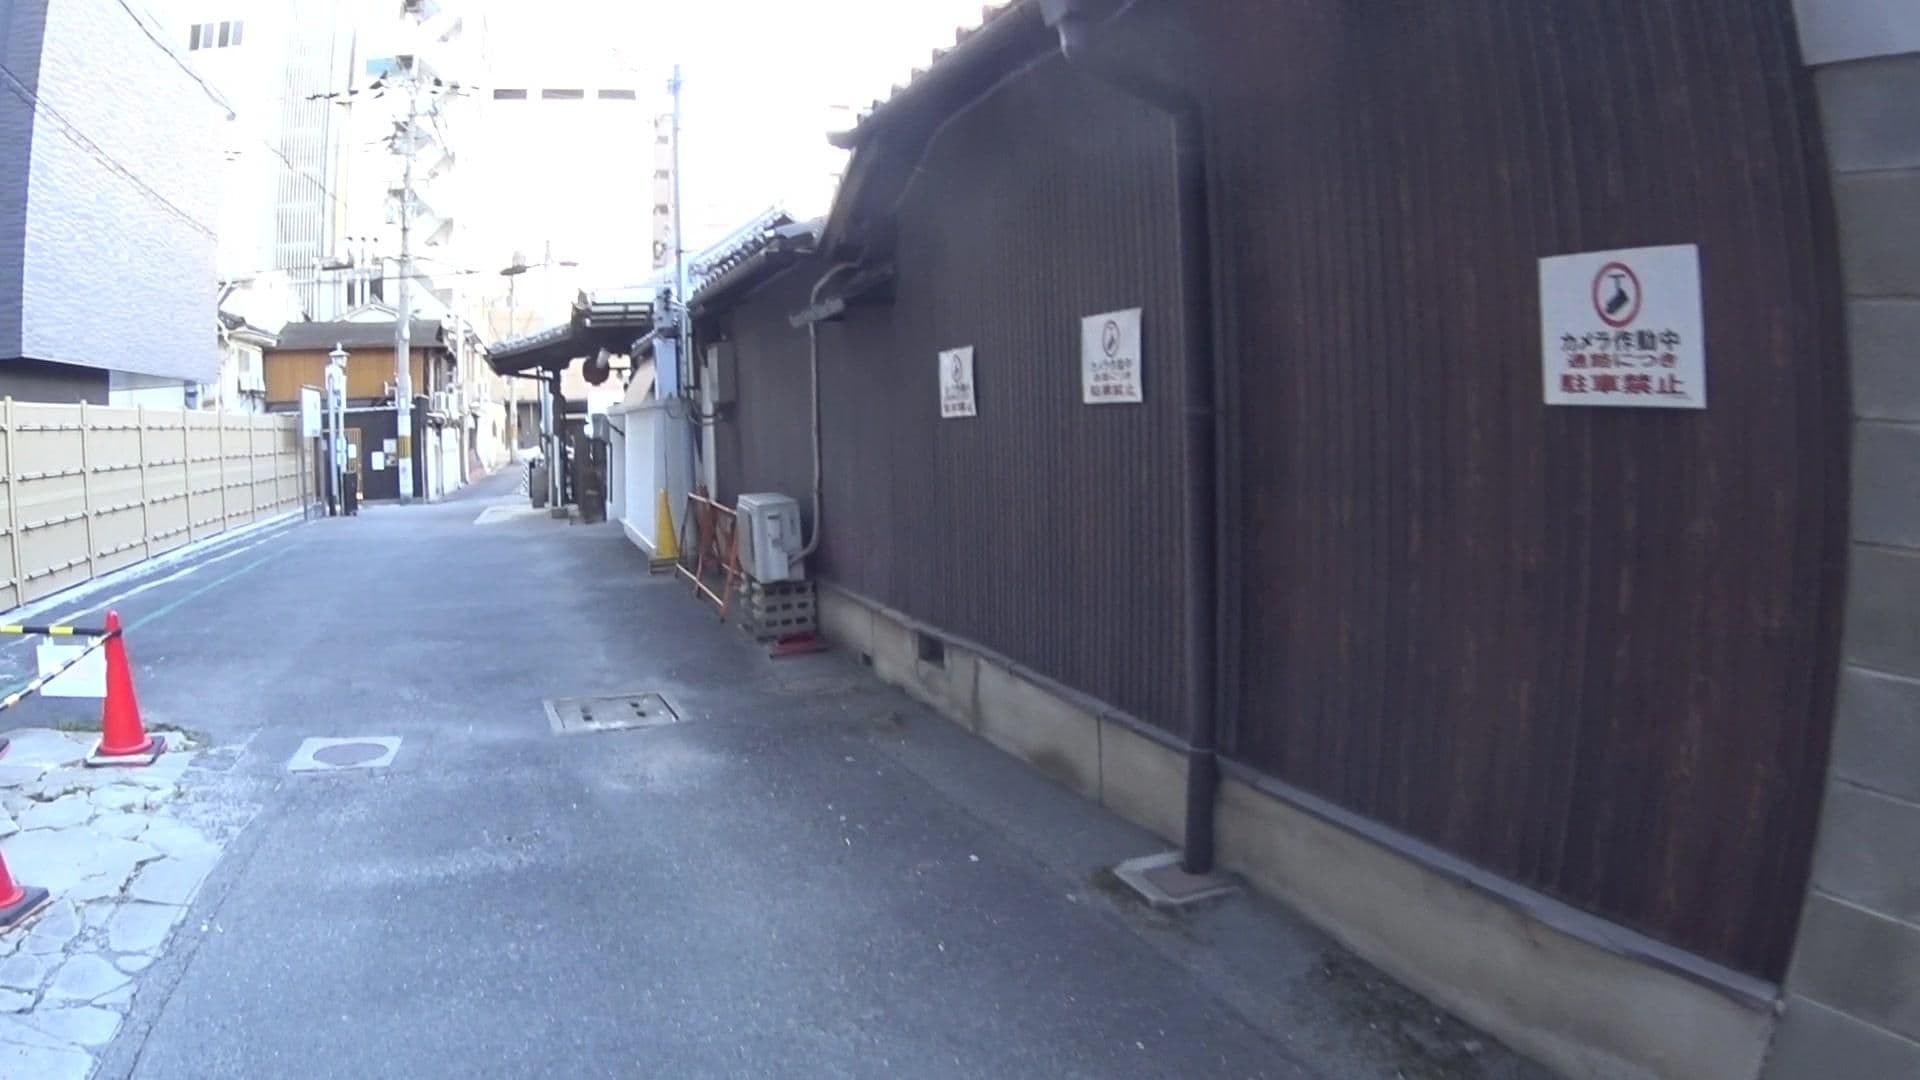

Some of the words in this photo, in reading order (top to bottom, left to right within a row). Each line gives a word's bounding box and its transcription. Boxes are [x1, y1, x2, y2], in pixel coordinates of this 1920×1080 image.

[1560, 329, 1681, 351] カメラ作動中
[1560, 373, 1687, 395] 駐車禁止
